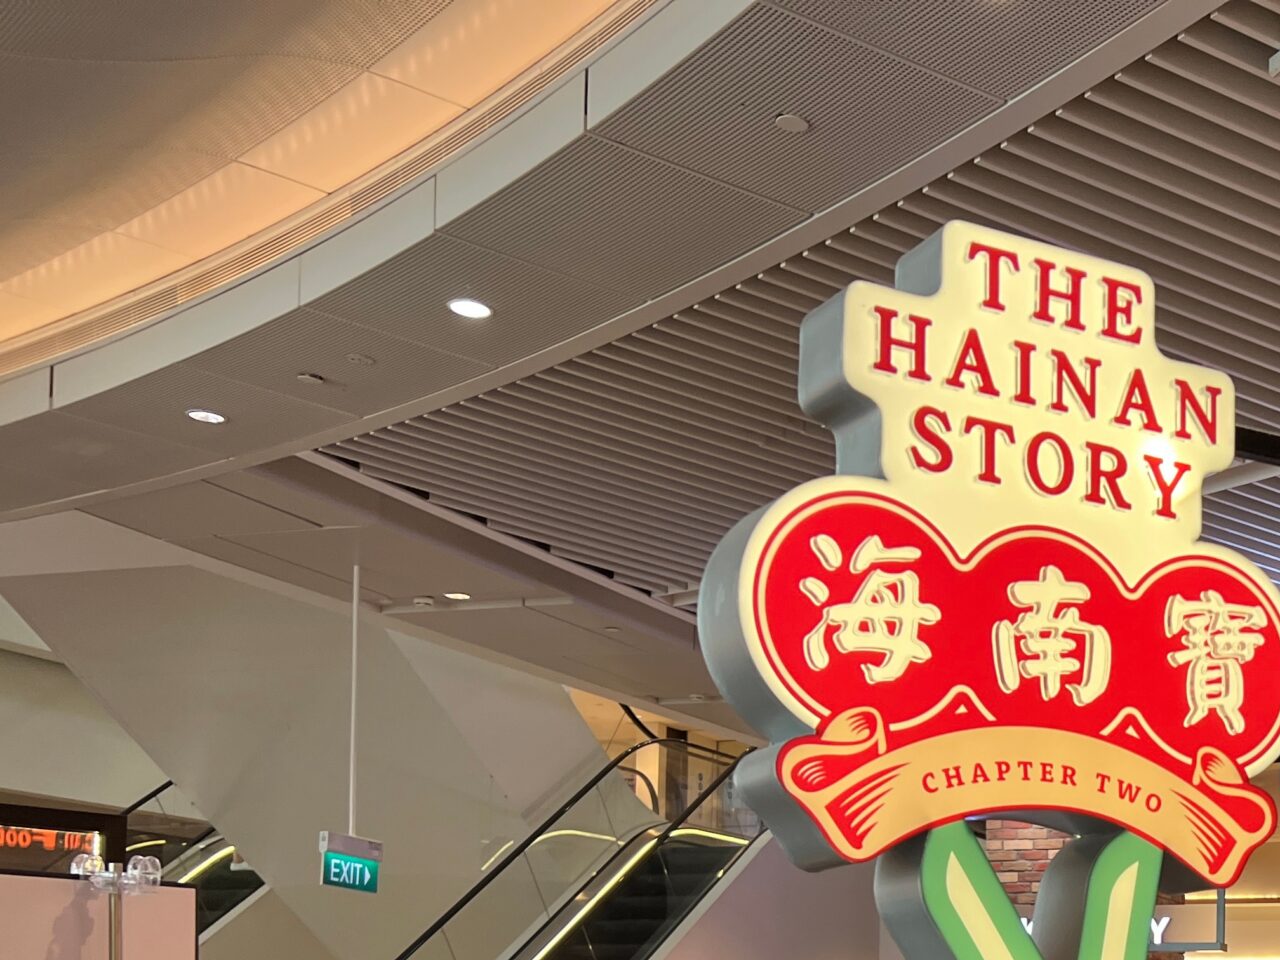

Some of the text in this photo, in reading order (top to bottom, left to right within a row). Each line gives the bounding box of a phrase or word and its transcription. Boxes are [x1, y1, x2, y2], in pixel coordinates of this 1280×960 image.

[967, 241, 1144, 345] THE
[872, 305, 1222, 446] HAINAN
[908, 405, 1192, 520] STORY
[799, 532, 1269, 736] 海南寶
[921, 760, 1163, 813] CHAPTER TWO
[330, 858, 363, 886] EXIT
